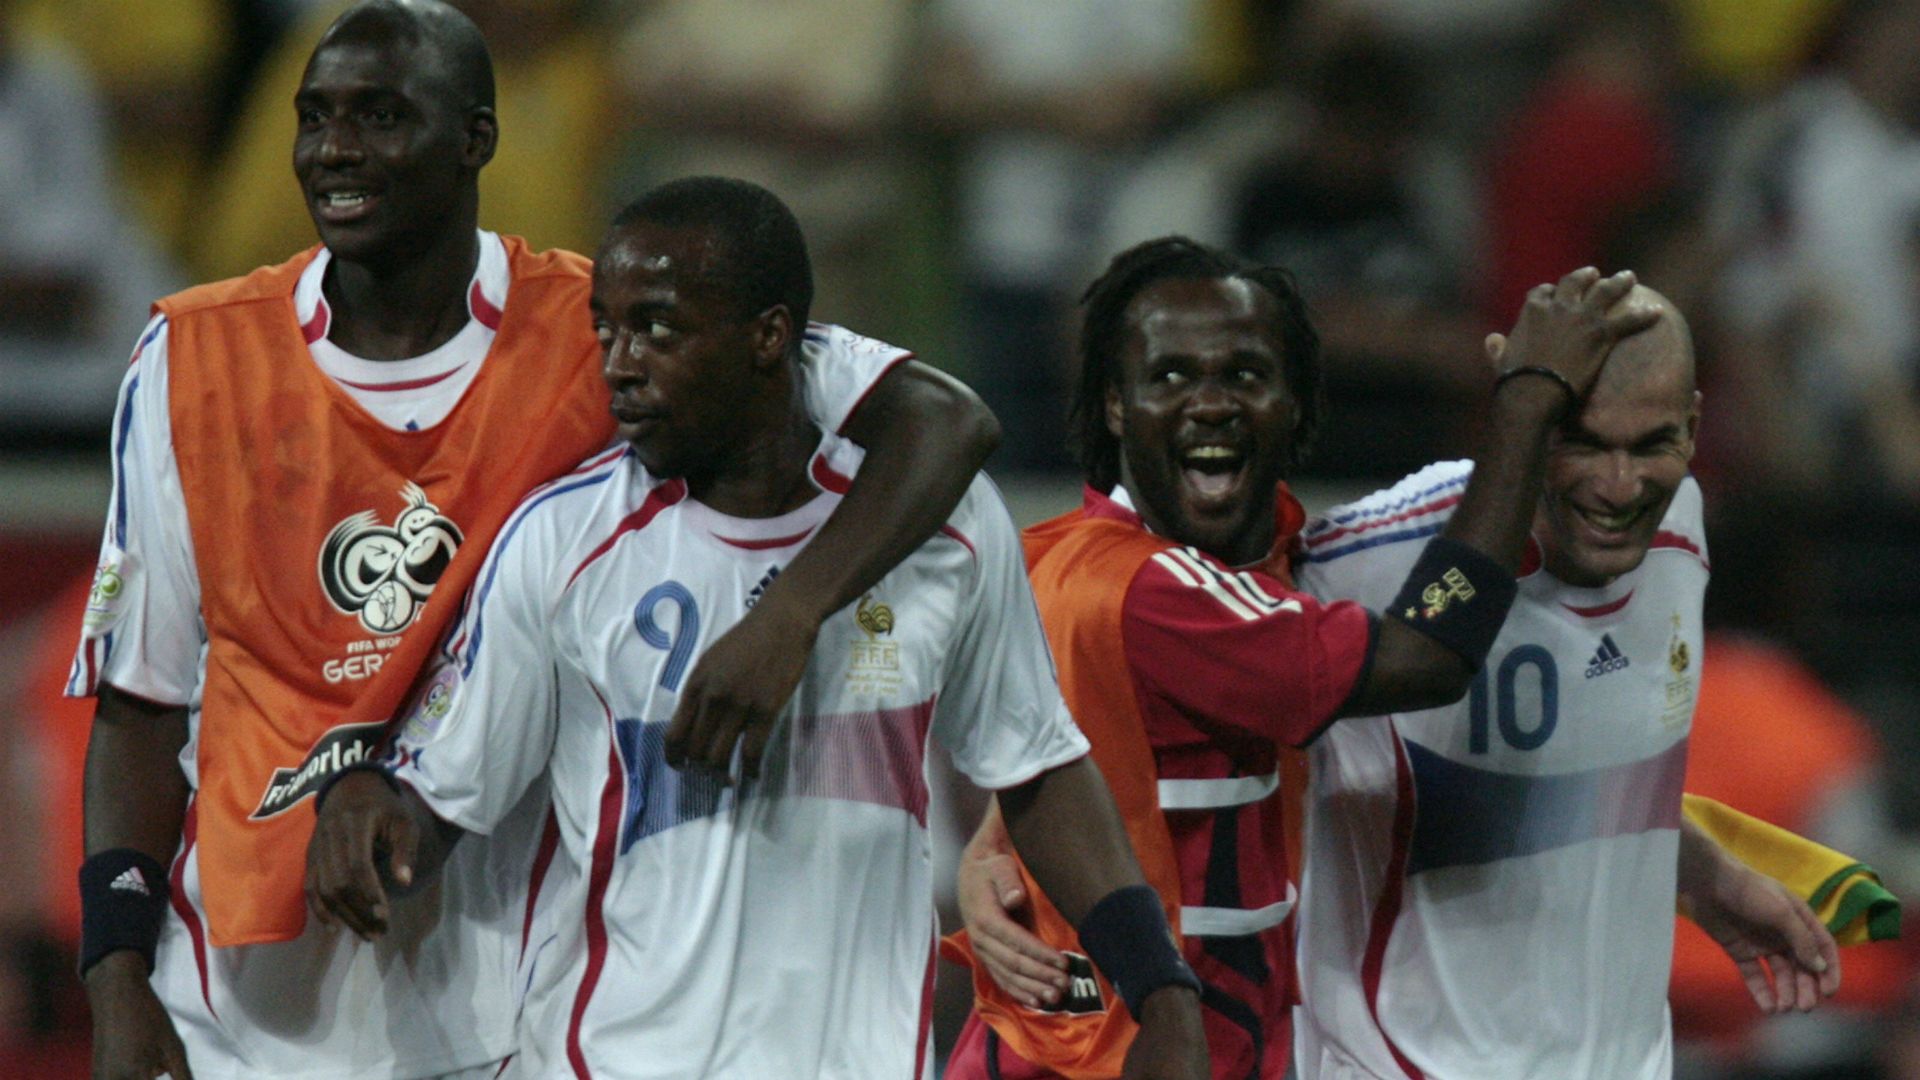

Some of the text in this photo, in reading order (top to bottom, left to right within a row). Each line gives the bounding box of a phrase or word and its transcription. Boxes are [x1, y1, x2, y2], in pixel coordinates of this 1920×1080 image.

[323, 652, 391, 683] GER
[634, 581, 698, 692] 9
[1585, 656, 1629, 679] adidas
[1469, 644, 1558, 754] 10
